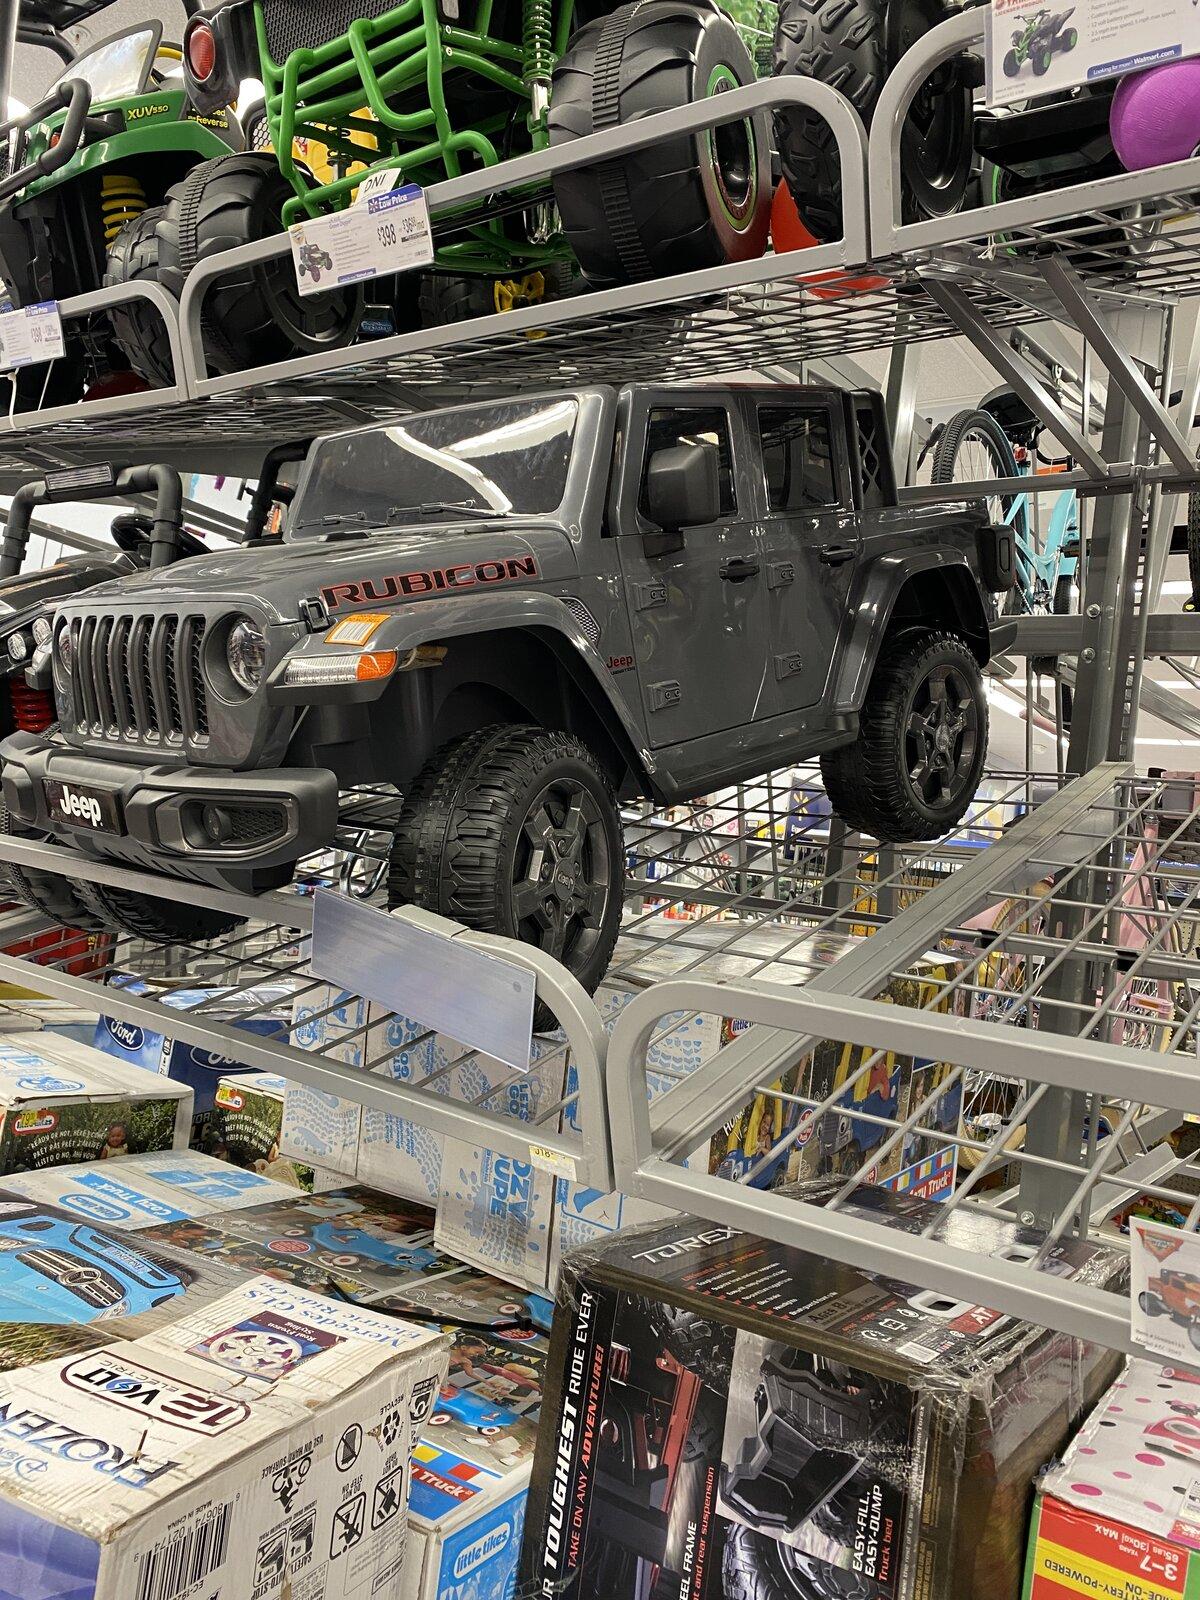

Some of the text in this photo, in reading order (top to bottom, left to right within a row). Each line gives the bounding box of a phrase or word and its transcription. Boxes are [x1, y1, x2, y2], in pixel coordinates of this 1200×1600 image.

[1093, 65, 1112, 75] Looking
[1133, 49, 1175, 64] Walmart.com
[196, 115, 229, 129] Reverse
[379, 199, 392, 209] Low
[391, 193, 408, 206] Price
[377, 223, 397, 247] $398
[320, 555, 538, 608] RUBICON
[606, 655, 634, 669] Jeep
[60, 785, 102, 827] Jeep
[111, 1018, 136, 1045] Ford
[90, 1182, 173, 1216] Cozy Truck
[490, 1155, 511, 1220] UPE
[507, 1157, 533, 1227] OZY
[631, 1226, 744, 1264] TOREX
[241, 1289, 407, 1349] Mercedes GLS
[260, 1281, 422, 1340] Electric Ride-On
[266, 1321, 317, 1342] Real Frozen
[284, 1321, 315, 1336] Styling
[101, 1359, 180, 1393] ELECTRIC
[71, 1367, 237, 1427] 12 VOLT
[379, 1393, 405, 1416] RECYCLE
[543, 1395, 578, 1570] TOUGHEST
[568, 1346, 586, 1396] RIDE
[577, 1291, 593, 1346] EVER
[261, 1434, 324, 1479] USE ON HARD SURFACE
[567, 1344, 605, 1569] TAKE ON ANY ADVENTURE!
[341, 1474, 363, 1493] STEP ON
[341, 1484, 361, 1501] DO NOT
[419, 1471, 463, 1498] Truck
[167, 1499, 213, 1531] MADE IN CHINA
[195, 1502, 224, 1529] 80674
[694, 1466, 714, 1589] and rear suspension
[864, 1484, 883, 1577] EASY-DUMP
[1094, 1523, 1119, 1540] MAX
[154, 1526, 186, 1553] 02174
[456, 1530, 508, 1573] little tikes
[682, 1520, 697, 1573] FRAME
[878, 1517, 893, 1581] Truck bed
[1118, 1544, 1139, 1557] YEARS
[250, 1569, 285, 1600] UTO-STOP
[291, 1552, 313, 1576] SAFETY
